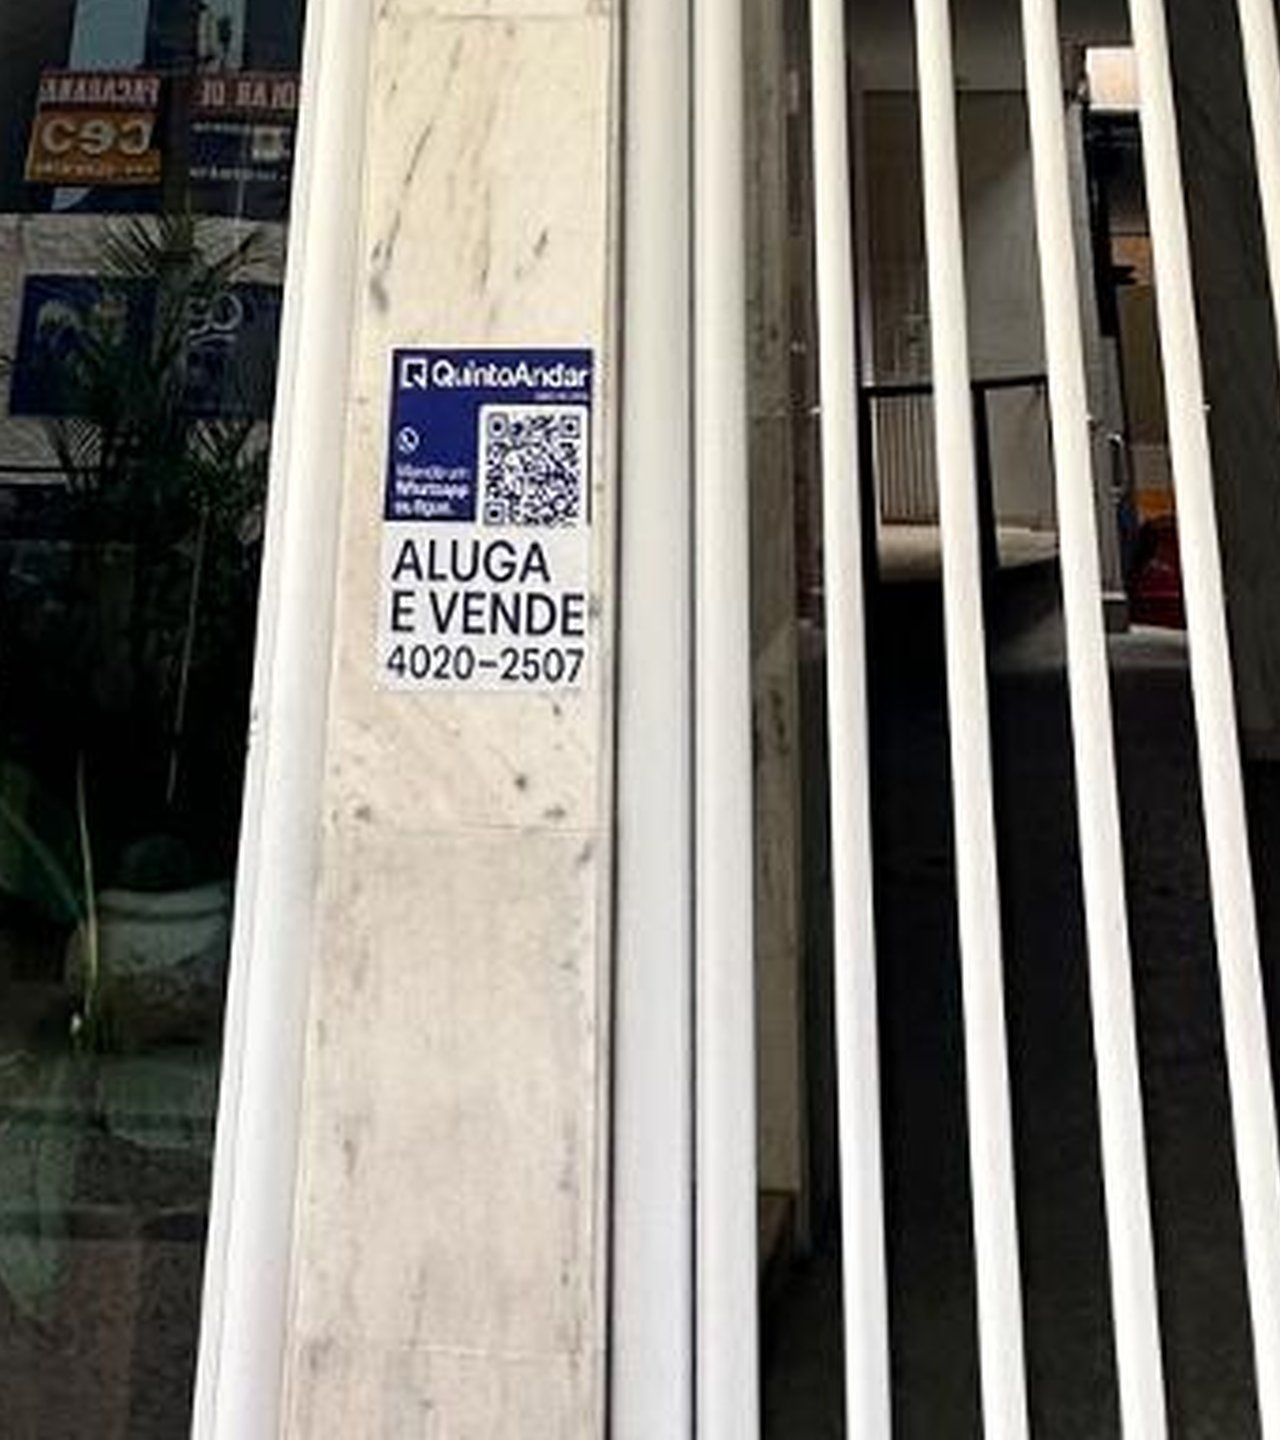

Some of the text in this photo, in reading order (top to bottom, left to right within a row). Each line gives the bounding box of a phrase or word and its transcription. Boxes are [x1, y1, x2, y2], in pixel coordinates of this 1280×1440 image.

[431, 359, 588, 388] QuintoAndar
[391, 539, 551, 582] ALUGA
[391, 591, 585, 637] E VENDE
[387, 645, 585, 682] 4020-2507
